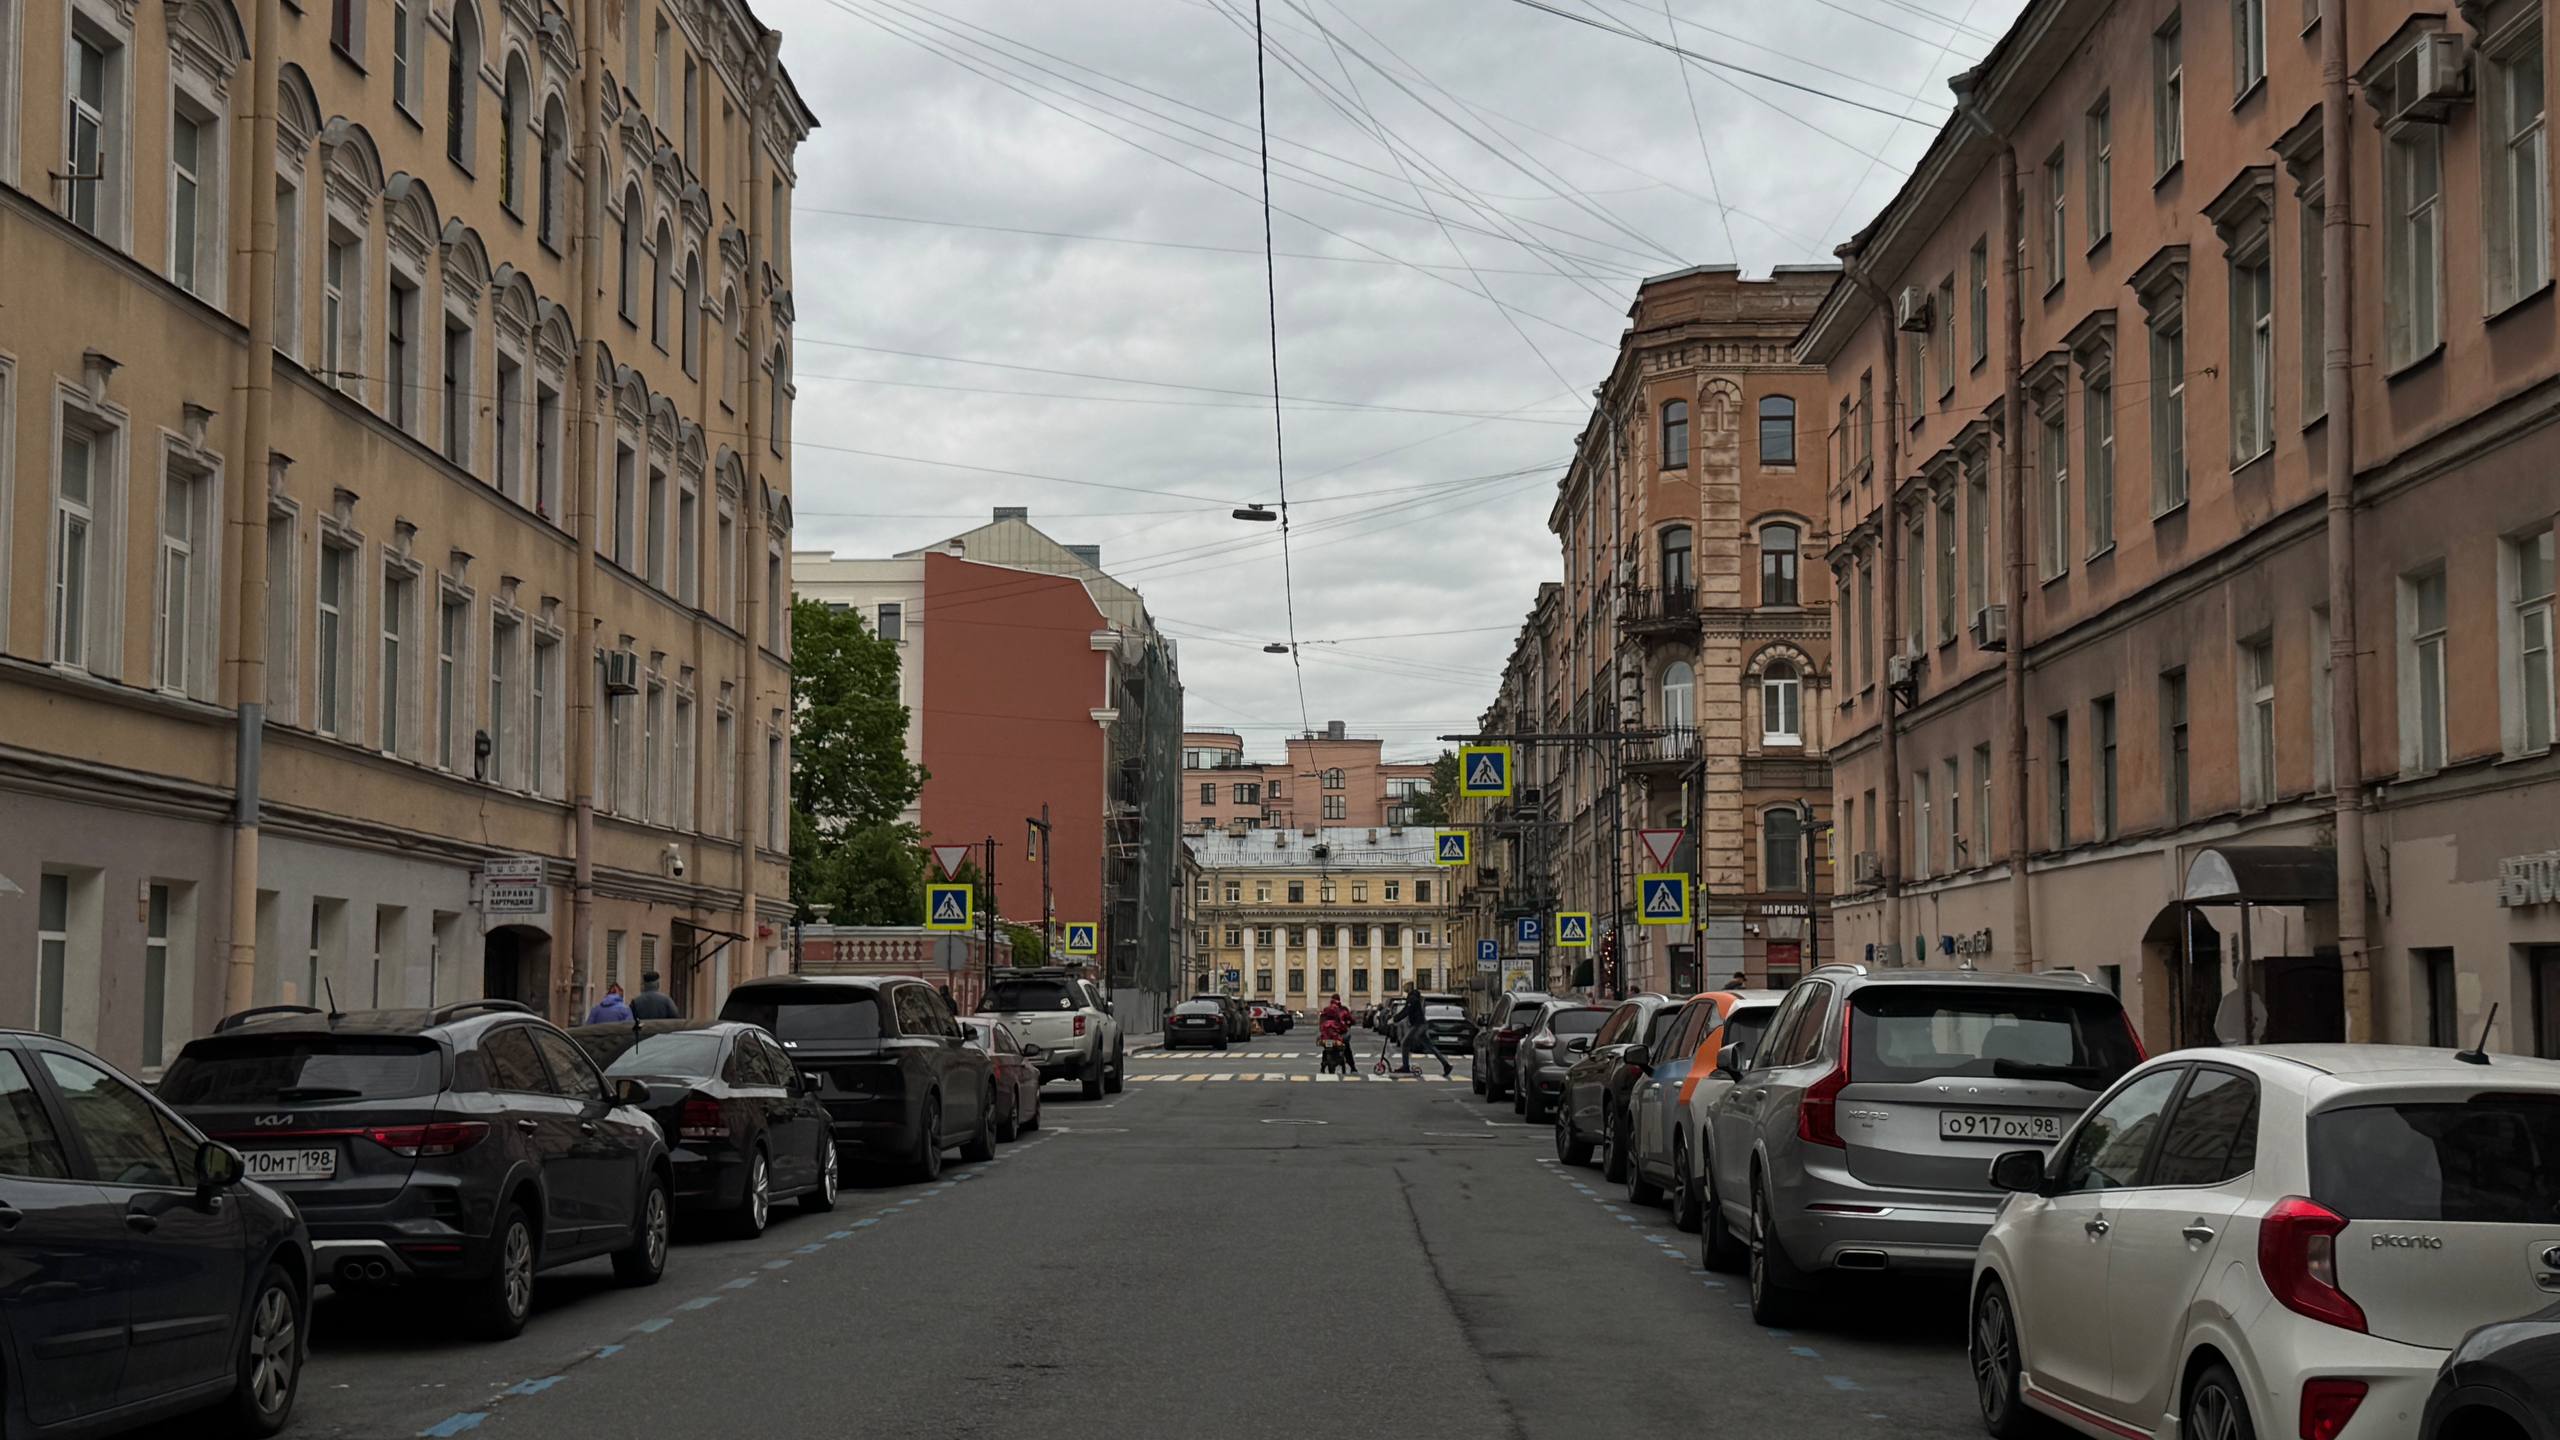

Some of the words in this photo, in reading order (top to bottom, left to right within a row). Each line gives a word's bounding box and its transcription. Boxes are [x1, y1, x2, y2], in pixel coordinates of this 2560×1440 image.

[491, 889, 534, 898] ЗАПРАВКА
[490, 898, 534, 907] КАРТРИДЖЕЙ
[1761, 904, 1809, 915] КАРНИЗЫ
[2033, 1118, 2054, 1133] 98
[302, 1151, 330, 1166] 198
[2371, 1233, 2443, 1250] picanto
